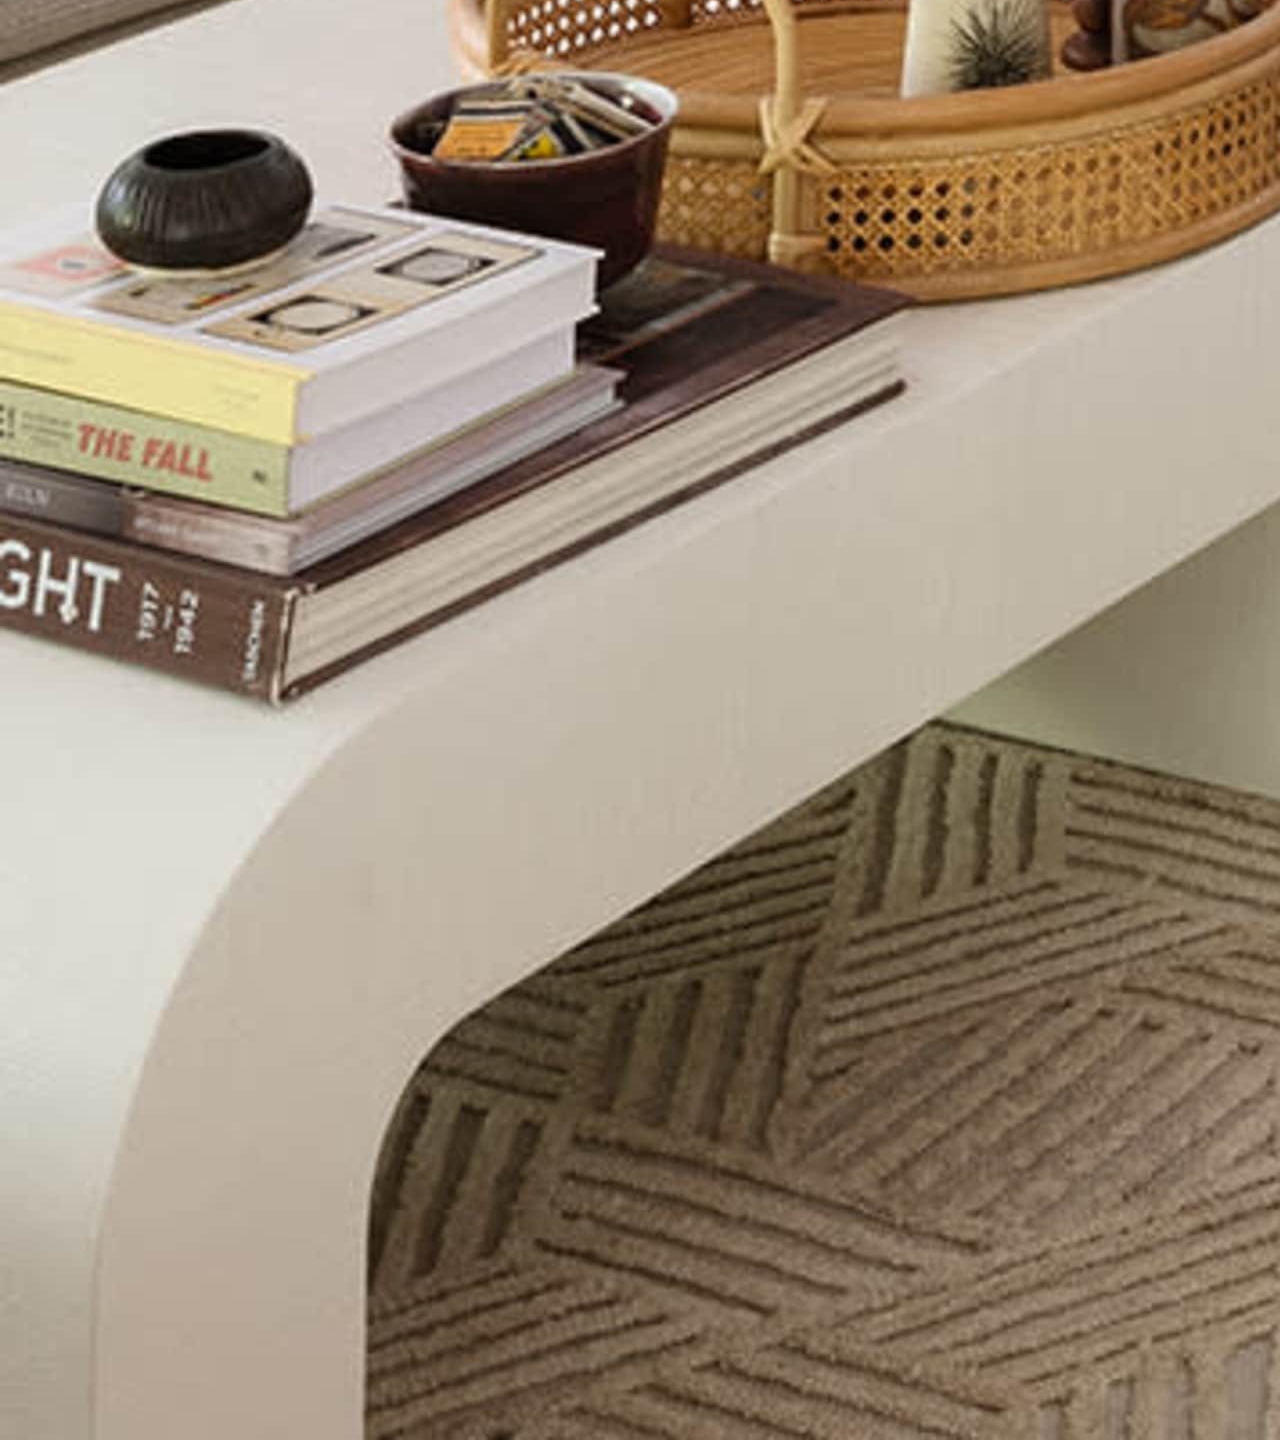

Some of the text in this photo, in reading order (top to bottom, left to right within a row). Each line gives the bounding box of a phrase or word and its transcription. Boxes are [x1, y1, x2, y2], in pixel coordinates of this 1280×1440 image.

[77, 423, 133, 462] THE
[141, 440, 213, 482] FALL
[0, 539, 120, 631] GHT
[138, 582, 161, 642] 1917
[175, 589, 200, 655] 1942
